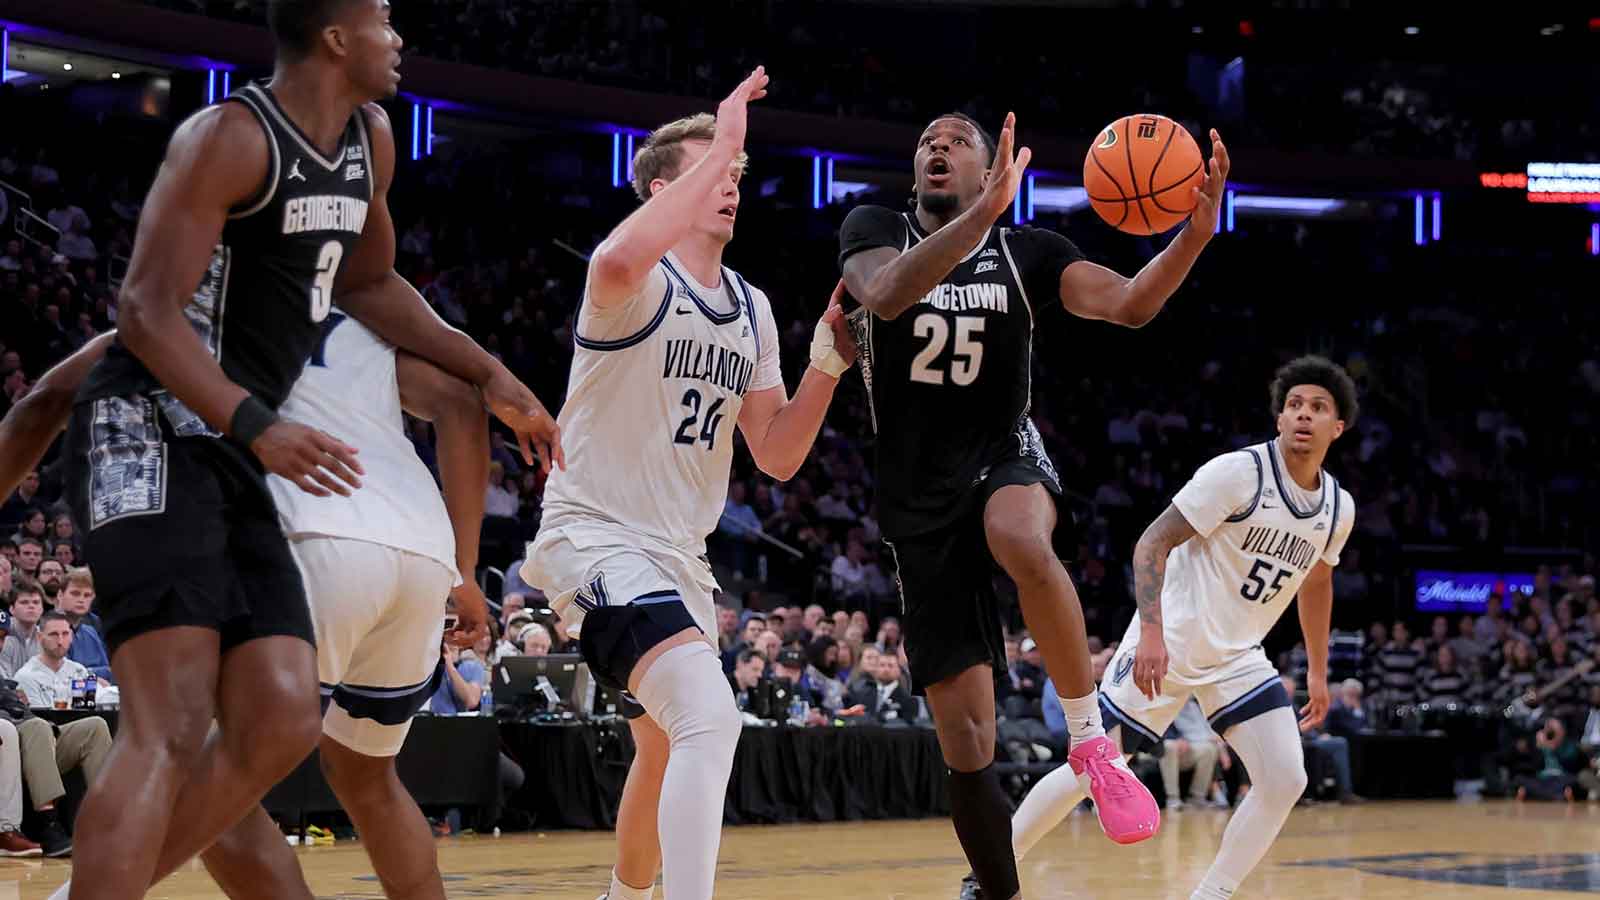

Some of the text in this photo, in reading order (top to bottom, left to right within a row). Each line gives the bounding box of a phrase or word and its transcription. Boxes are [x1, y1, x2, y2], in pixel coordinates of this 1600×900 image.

[310, 240, 344, 323] 3
[920, 283, 1009, 314] RGETOWN
[910, 313, 986, 386] 25
[674, 388, 728, 450] 24
[1240, 558, 1293, 605] 55
